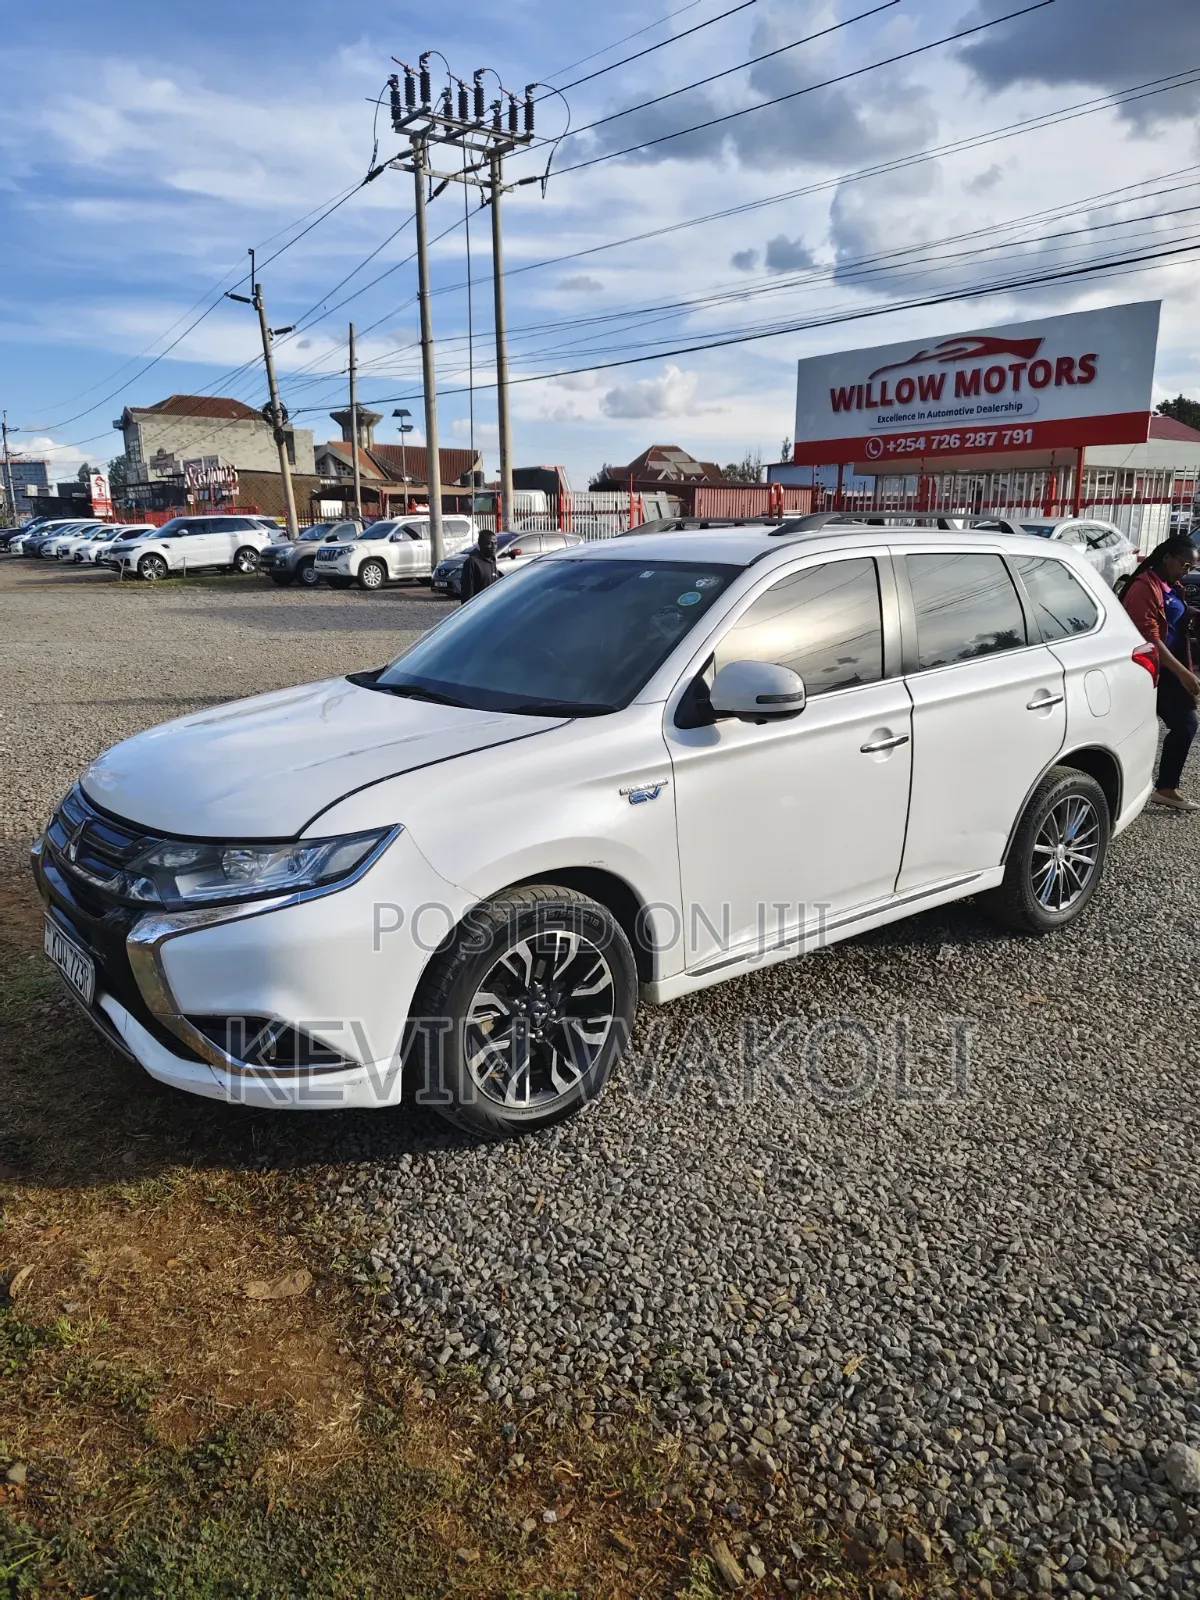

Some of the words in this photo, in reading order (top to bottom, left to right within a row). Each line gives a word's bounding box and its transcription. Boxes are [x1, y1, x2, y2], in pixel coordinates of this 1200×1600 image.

[829, 372, 946, 413] WILLOW
[954, 353, 1099, 398] MOTORS
[877, 413, 916, 424] Excellence
[917, 411, 926, 420] In
[926, 406, 975, 419] Automotive
[976, 401, 1023, 415] Dealership
[886, 436, 926, 453] +254
[930, 433, 961, 450] 726
[964, 431, 998, 448] 287
[1001, 428, 1033, 446] 791
[628, 786, 662, 805] EV
